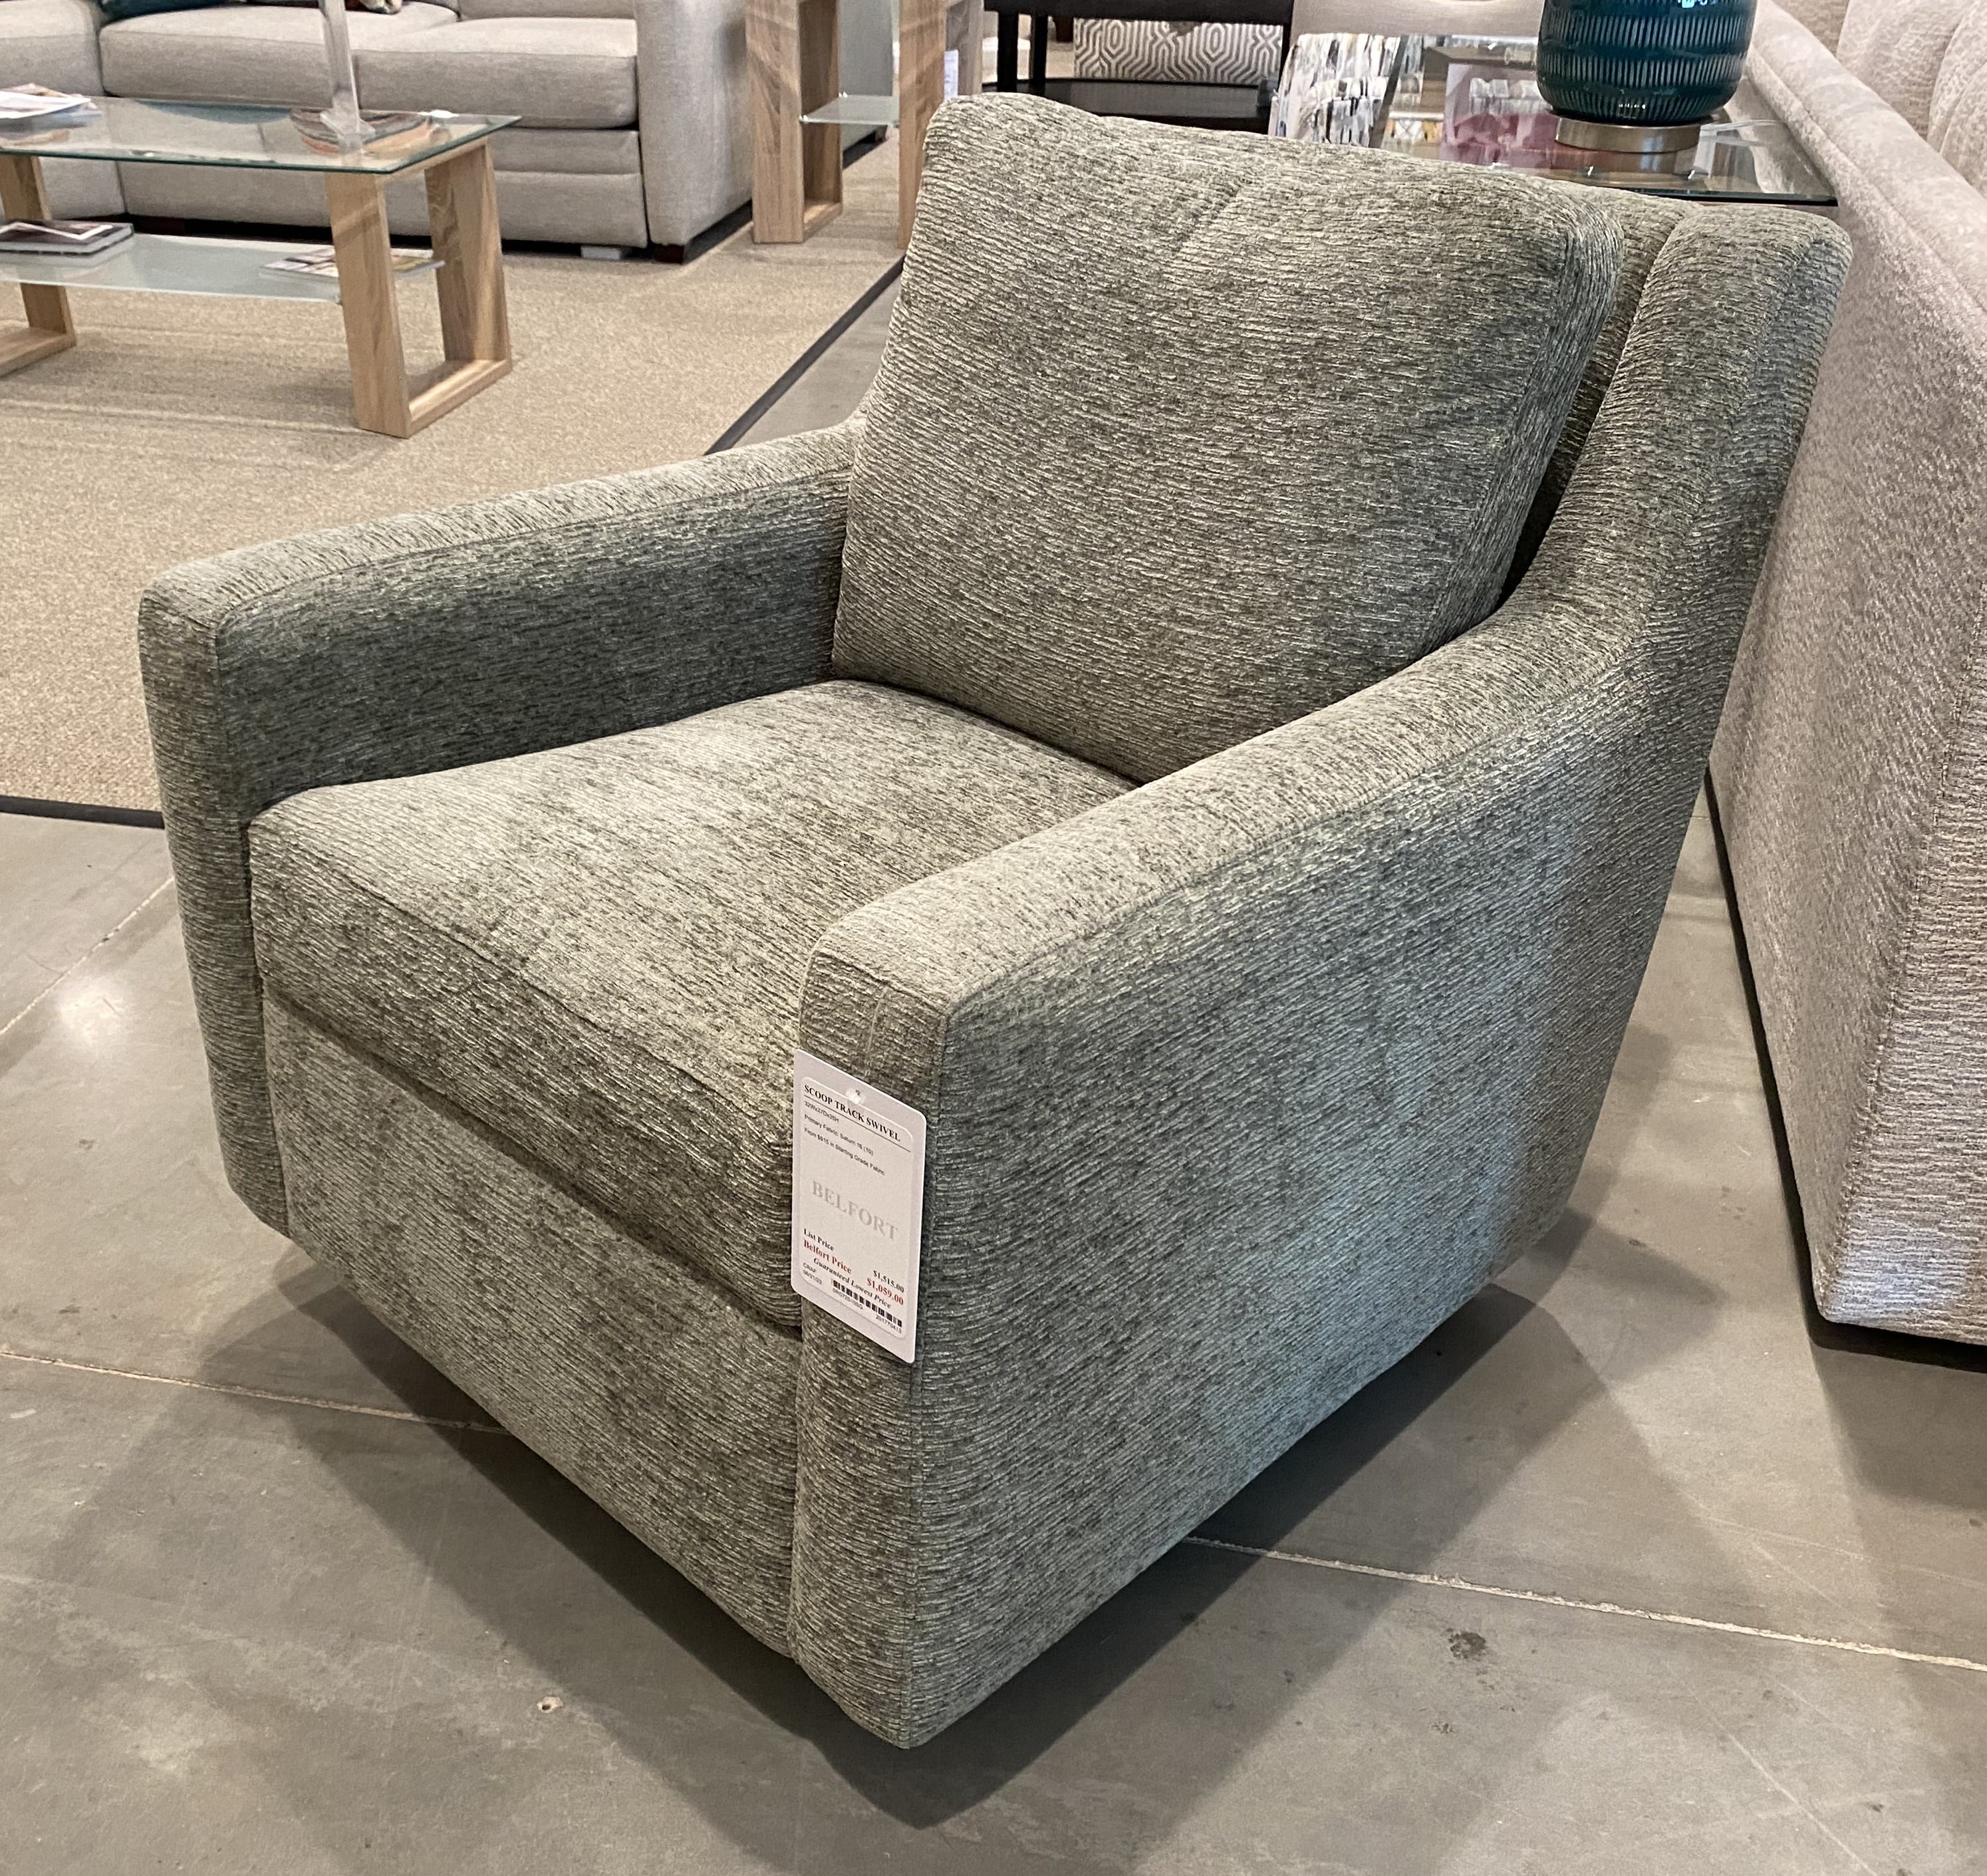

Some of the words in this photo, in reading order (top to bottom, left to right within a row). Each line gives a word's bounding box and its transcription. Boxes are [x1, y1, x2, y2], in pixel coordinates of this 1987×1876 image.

[804, 1084, 833, 1105] SCOOP
[835, 1100, 864, 1123] TRACK
[866, 1117, 900, 1142] SWIVEL
[804, 1114, 822, 1129] Primary
[804, 1127, 817, 1137] From
[835, 1144, 853, 1159] Starting
[854, 1154, 868, 1167] Grade
[870, 1163, 885, 1176] Fabric
[811, 1180, 899, 1240] BELFORT
[803, 1228, 816, 1242] List
[817, 1236, 835, 1252] Price
[872, 1270, 904, 1293] $1,515.00
[803, 1238, 830, 1262] Belfort
[831, 1256, 852, 1274] Price
[866, 1277, 904, 1305] $1,059.00
[813, 1258, 851, 1283] Guaranteed
[851, 1279, 872, 1297] Lowest
[874, 1294, 891, 1309] Price
